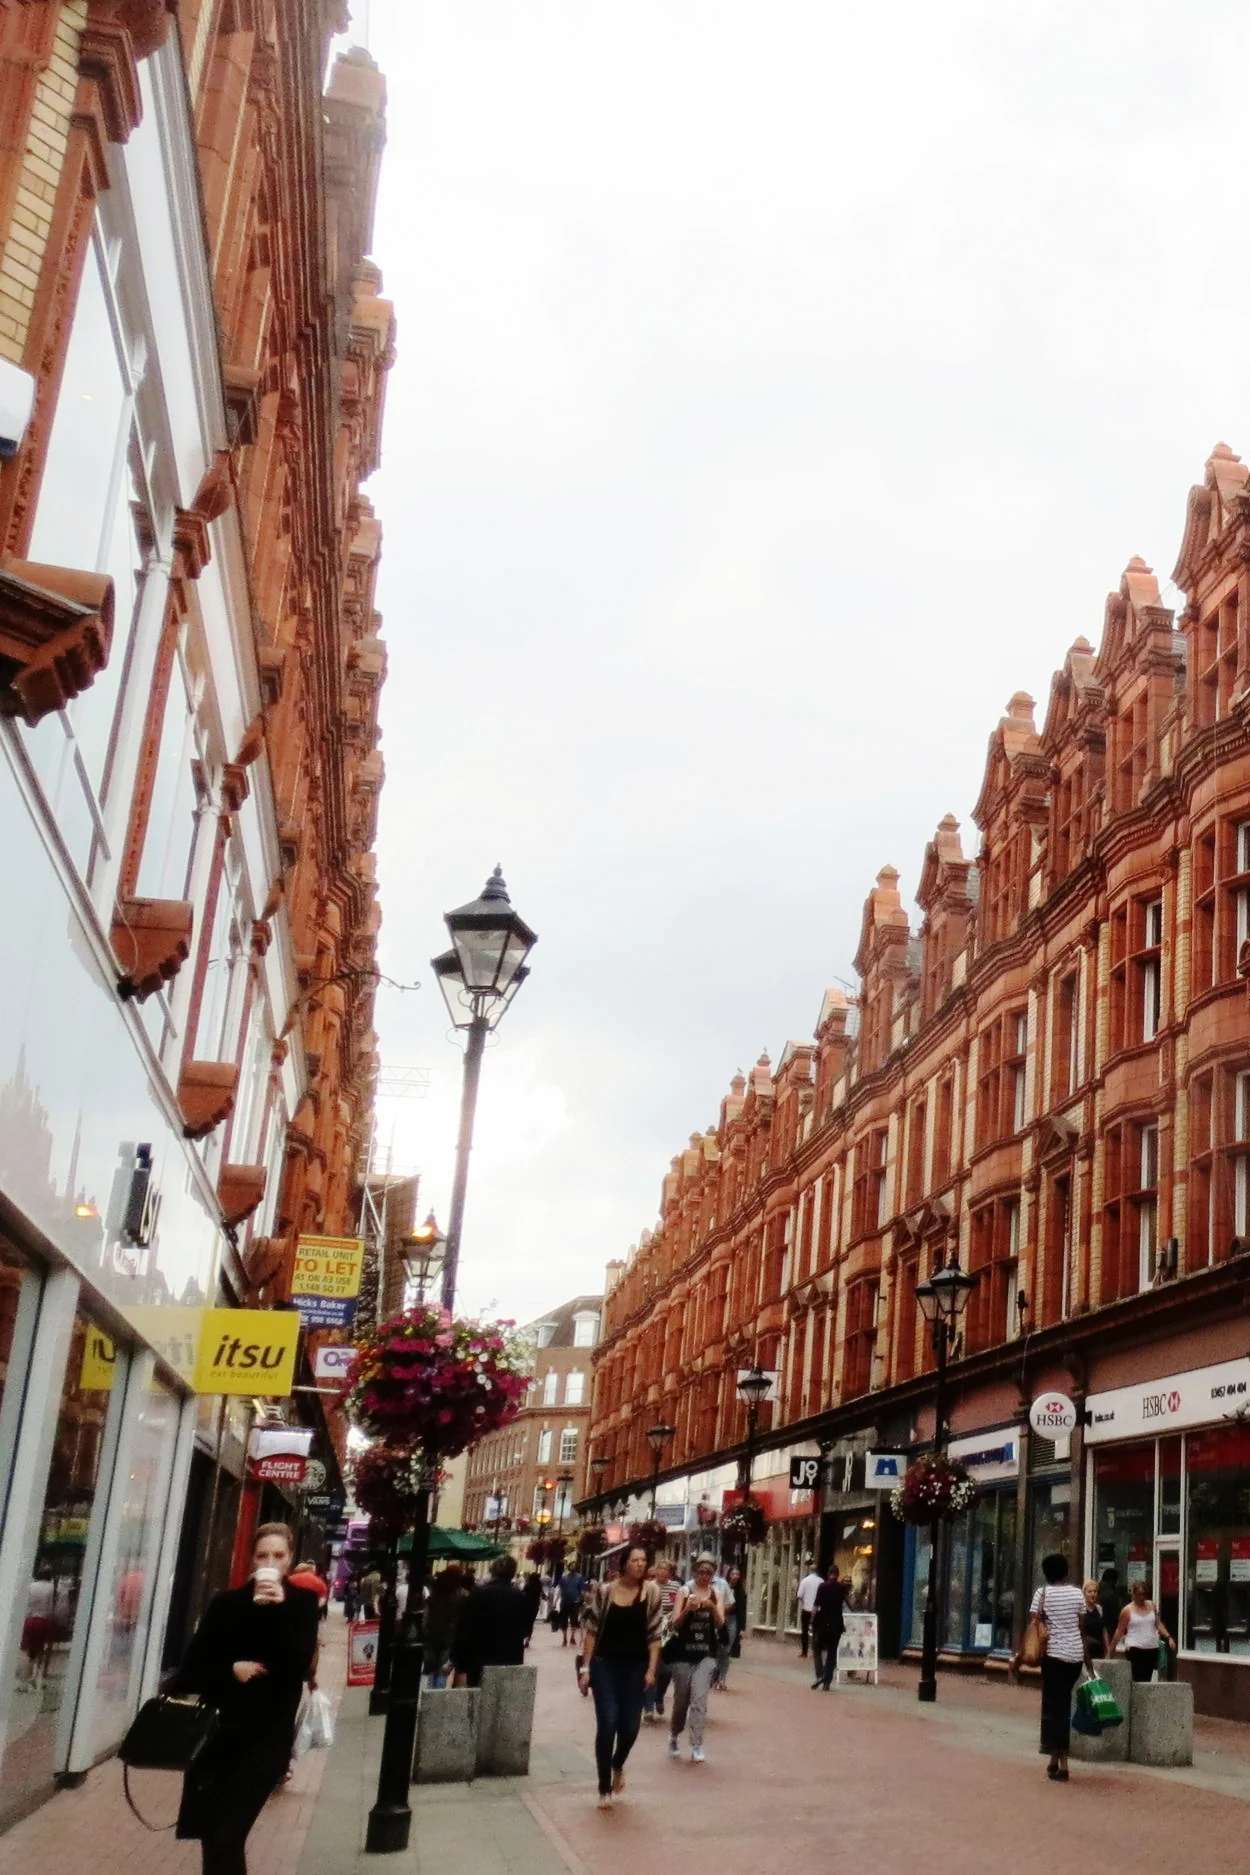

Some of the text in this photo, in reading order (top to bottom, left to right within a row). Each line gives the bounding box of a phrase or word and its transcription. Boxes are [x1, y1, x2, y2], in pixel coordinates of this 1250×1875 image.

[298, 1248, 355, 1260] RETAIL UNIT
[294, 1258, 357, 1275] TO LET
[320, 1299, 347, 1309] Baker
[212, 1334, 286, 1369] itsu
[1143, 1394, 1167, 1419] HSBC
[1036, 1414, 1072, 1427] HSBC
[261, 1460, 300, 1470] FLIGHT
[258, 1469, 300, 1480] CENTRE
[792, 1460, 819, 1485] JOY
[307, 1496, 330, 1505] VANS
